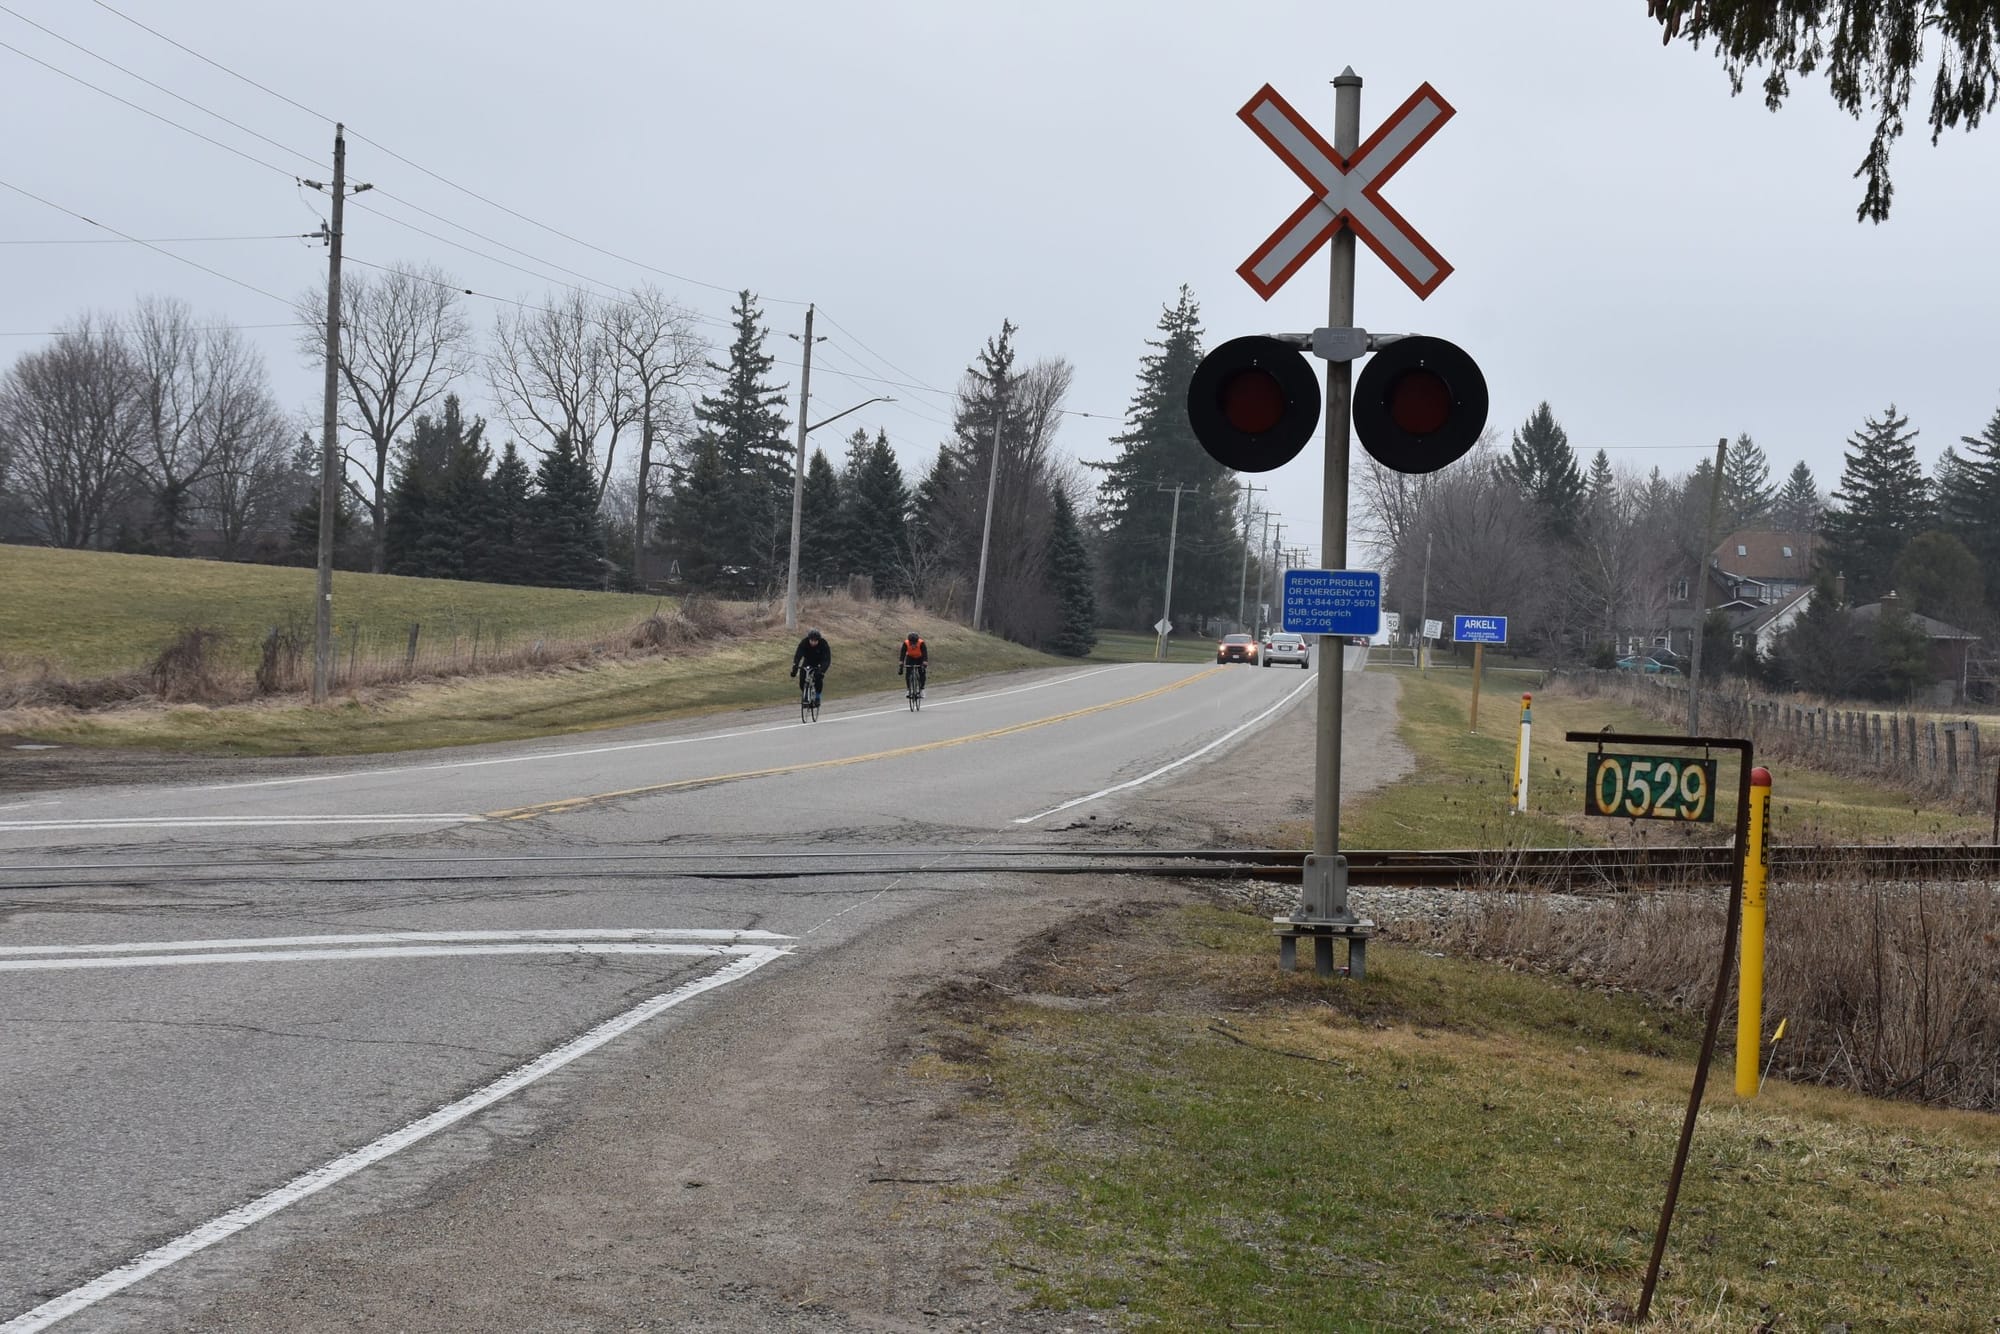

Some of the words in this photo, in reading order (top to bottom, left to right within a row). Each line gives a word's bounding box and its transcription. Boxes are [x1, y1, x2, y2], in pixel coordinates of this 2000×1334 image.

[1291, 578, 1328, 586] REPORT
[1329, 579, 1373, 587] PROBLEM
[1304, 588, 1361, 596] EMERGENCY
[1307, 598, 1376, 607] 1-844-837-5679
[1288, 608, 1309, 616] SUB:
[1311, 609, 1351, 617] Goderich
[1305, 618, 1332, 626] 27.06
[1464, 620, 1497, 630] ARKELL
[1595, 758, 1707, 820] 0529
